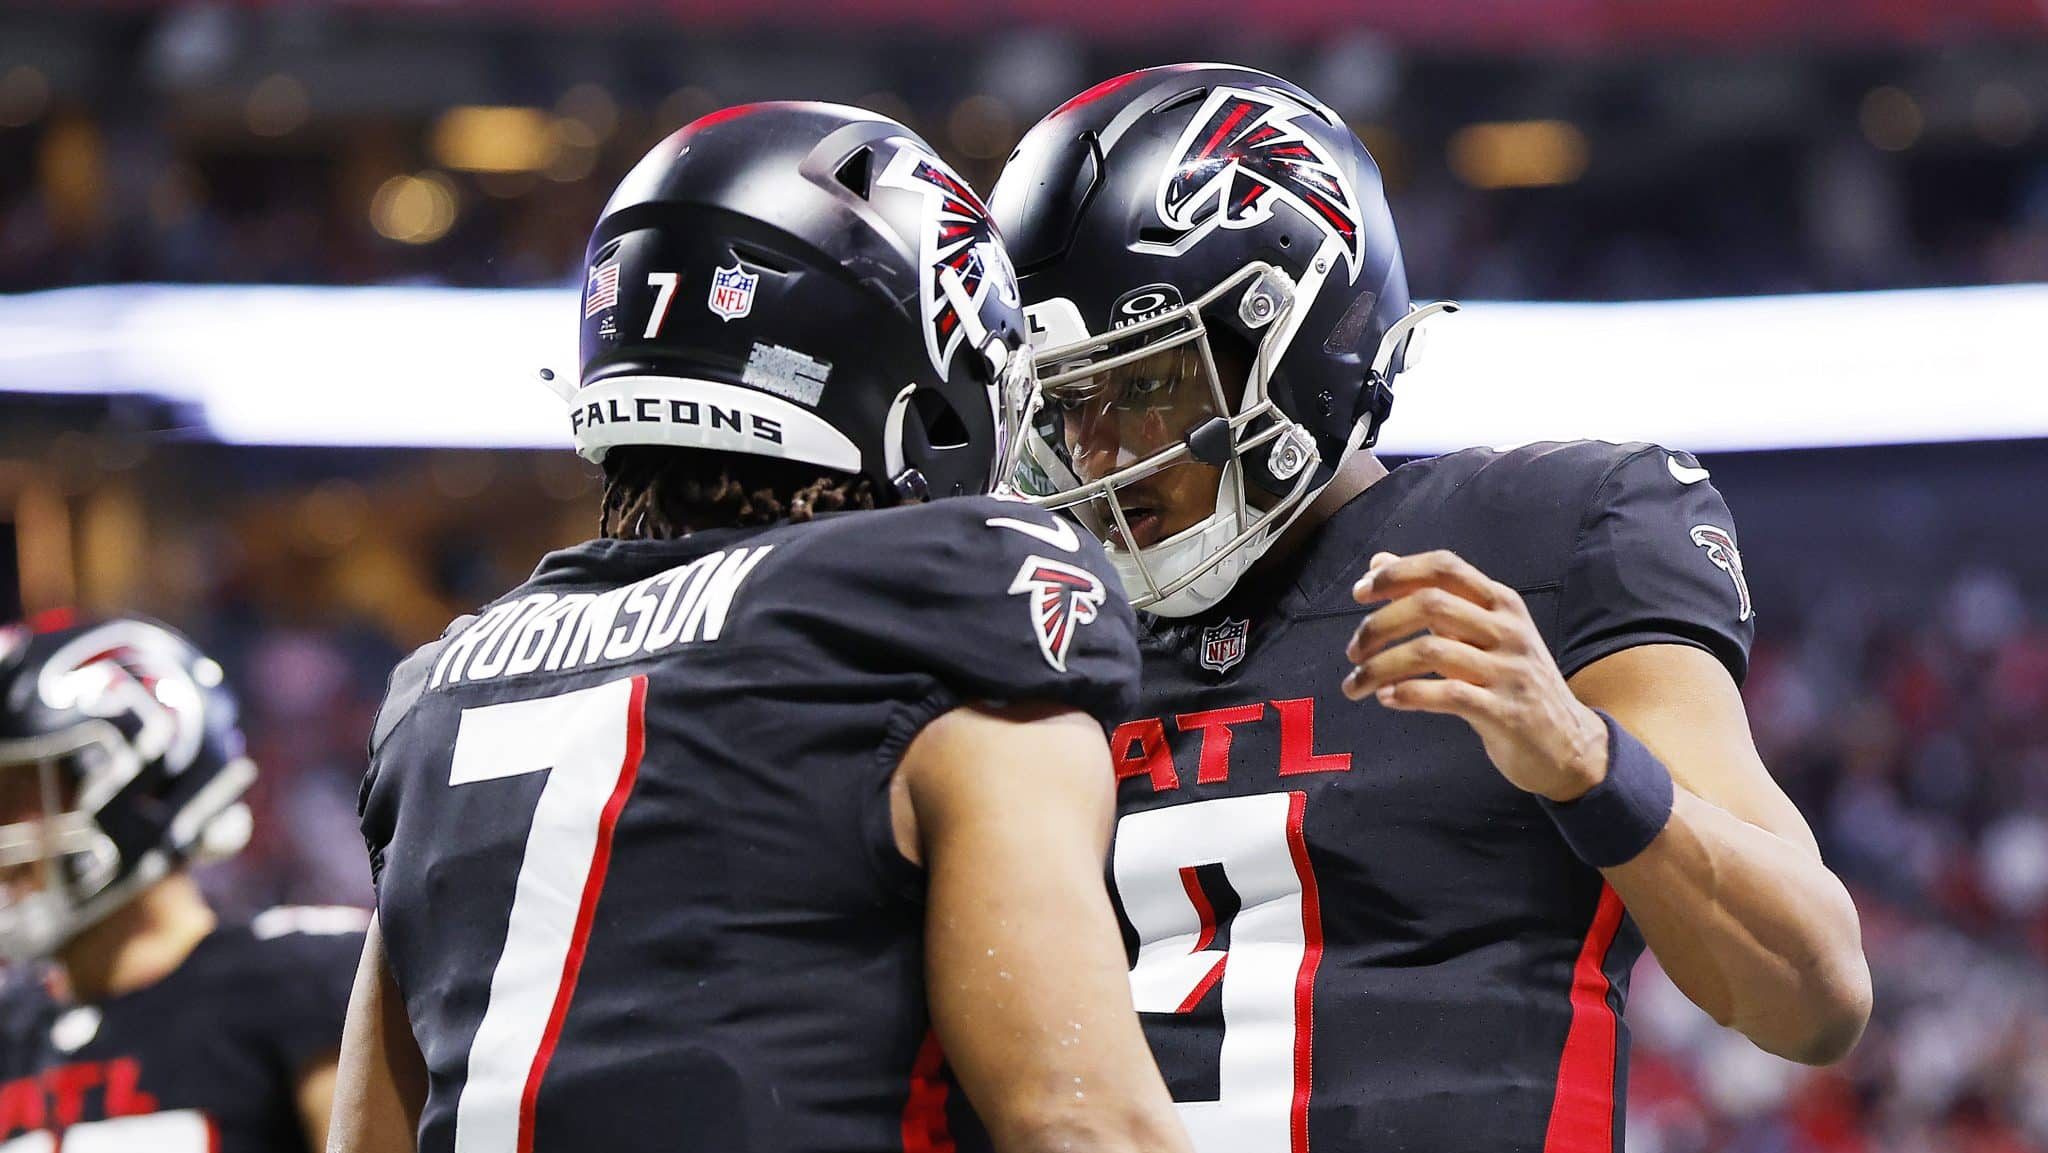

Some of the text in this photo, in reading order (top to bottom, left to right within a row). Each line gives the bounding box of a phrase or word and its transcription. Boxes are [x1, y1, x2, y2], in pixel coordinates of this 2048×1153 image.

[643, 272, 681, 339] 7
[715, 287, 745, 311] NFL
[570, 398, 783, 445] FALCONS
[429, 545, 774, 690] ROBINSON
[1207, 639, 1237, 662] NFL
[1110, 697, 1352, 791] ATL
[449, 674, 648, 1153] 7
[1113, 790, 1323, 1153] 9
